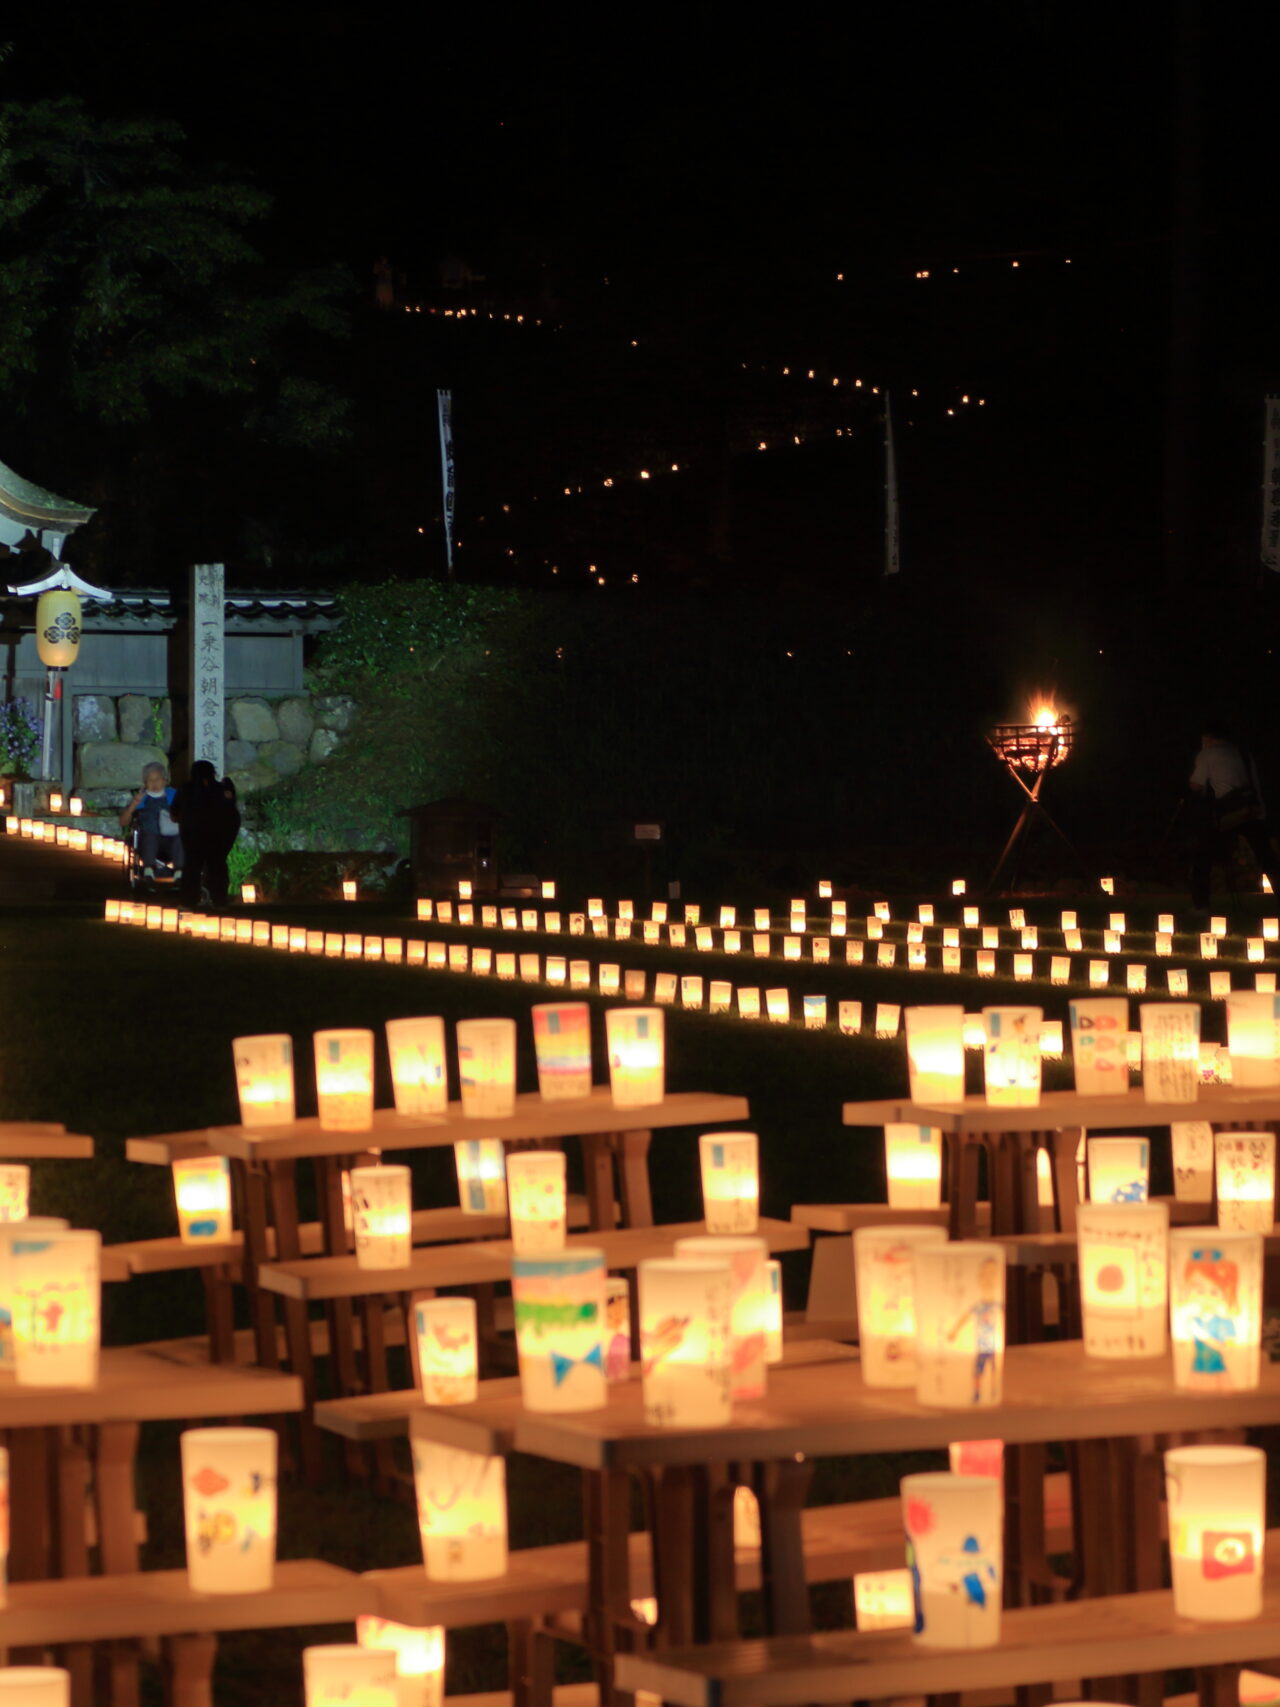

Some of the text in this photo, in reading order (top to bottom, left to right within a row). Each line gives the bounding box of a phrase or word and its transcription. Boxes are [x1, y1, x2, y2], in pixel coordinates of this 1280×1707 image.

[200, 620, 219, 775] 一乗谷朝倉氏遺
